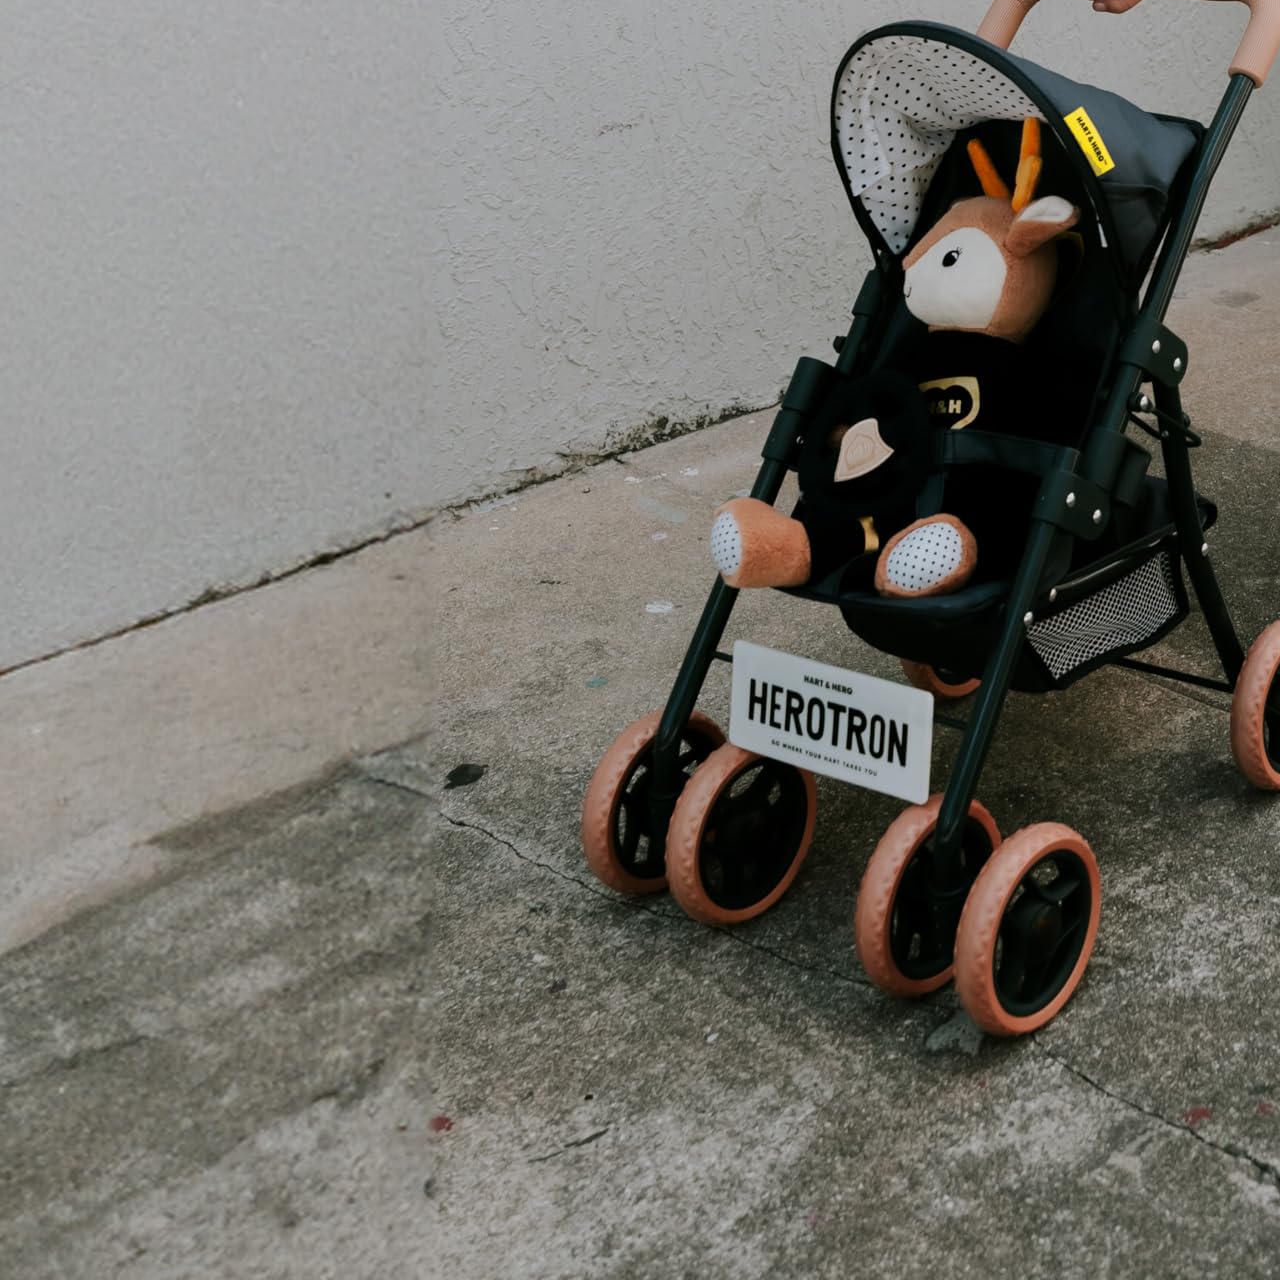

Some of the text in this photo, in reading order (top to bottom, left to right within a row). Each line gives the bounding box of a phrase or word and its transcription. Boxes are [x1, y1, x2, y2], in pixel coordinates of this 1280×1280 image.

[1076, 116, 1092, 136] HART
[803, 675, 853, 695] HART & HERO
[748, 678, 909, 768] HEROTRON
[782, 743, 803, 754] WHERE
[804, 750, 822, 760] YOUR
[842, 761, 862, 772] TAKES
[864, 768, 878, 776] YOU
